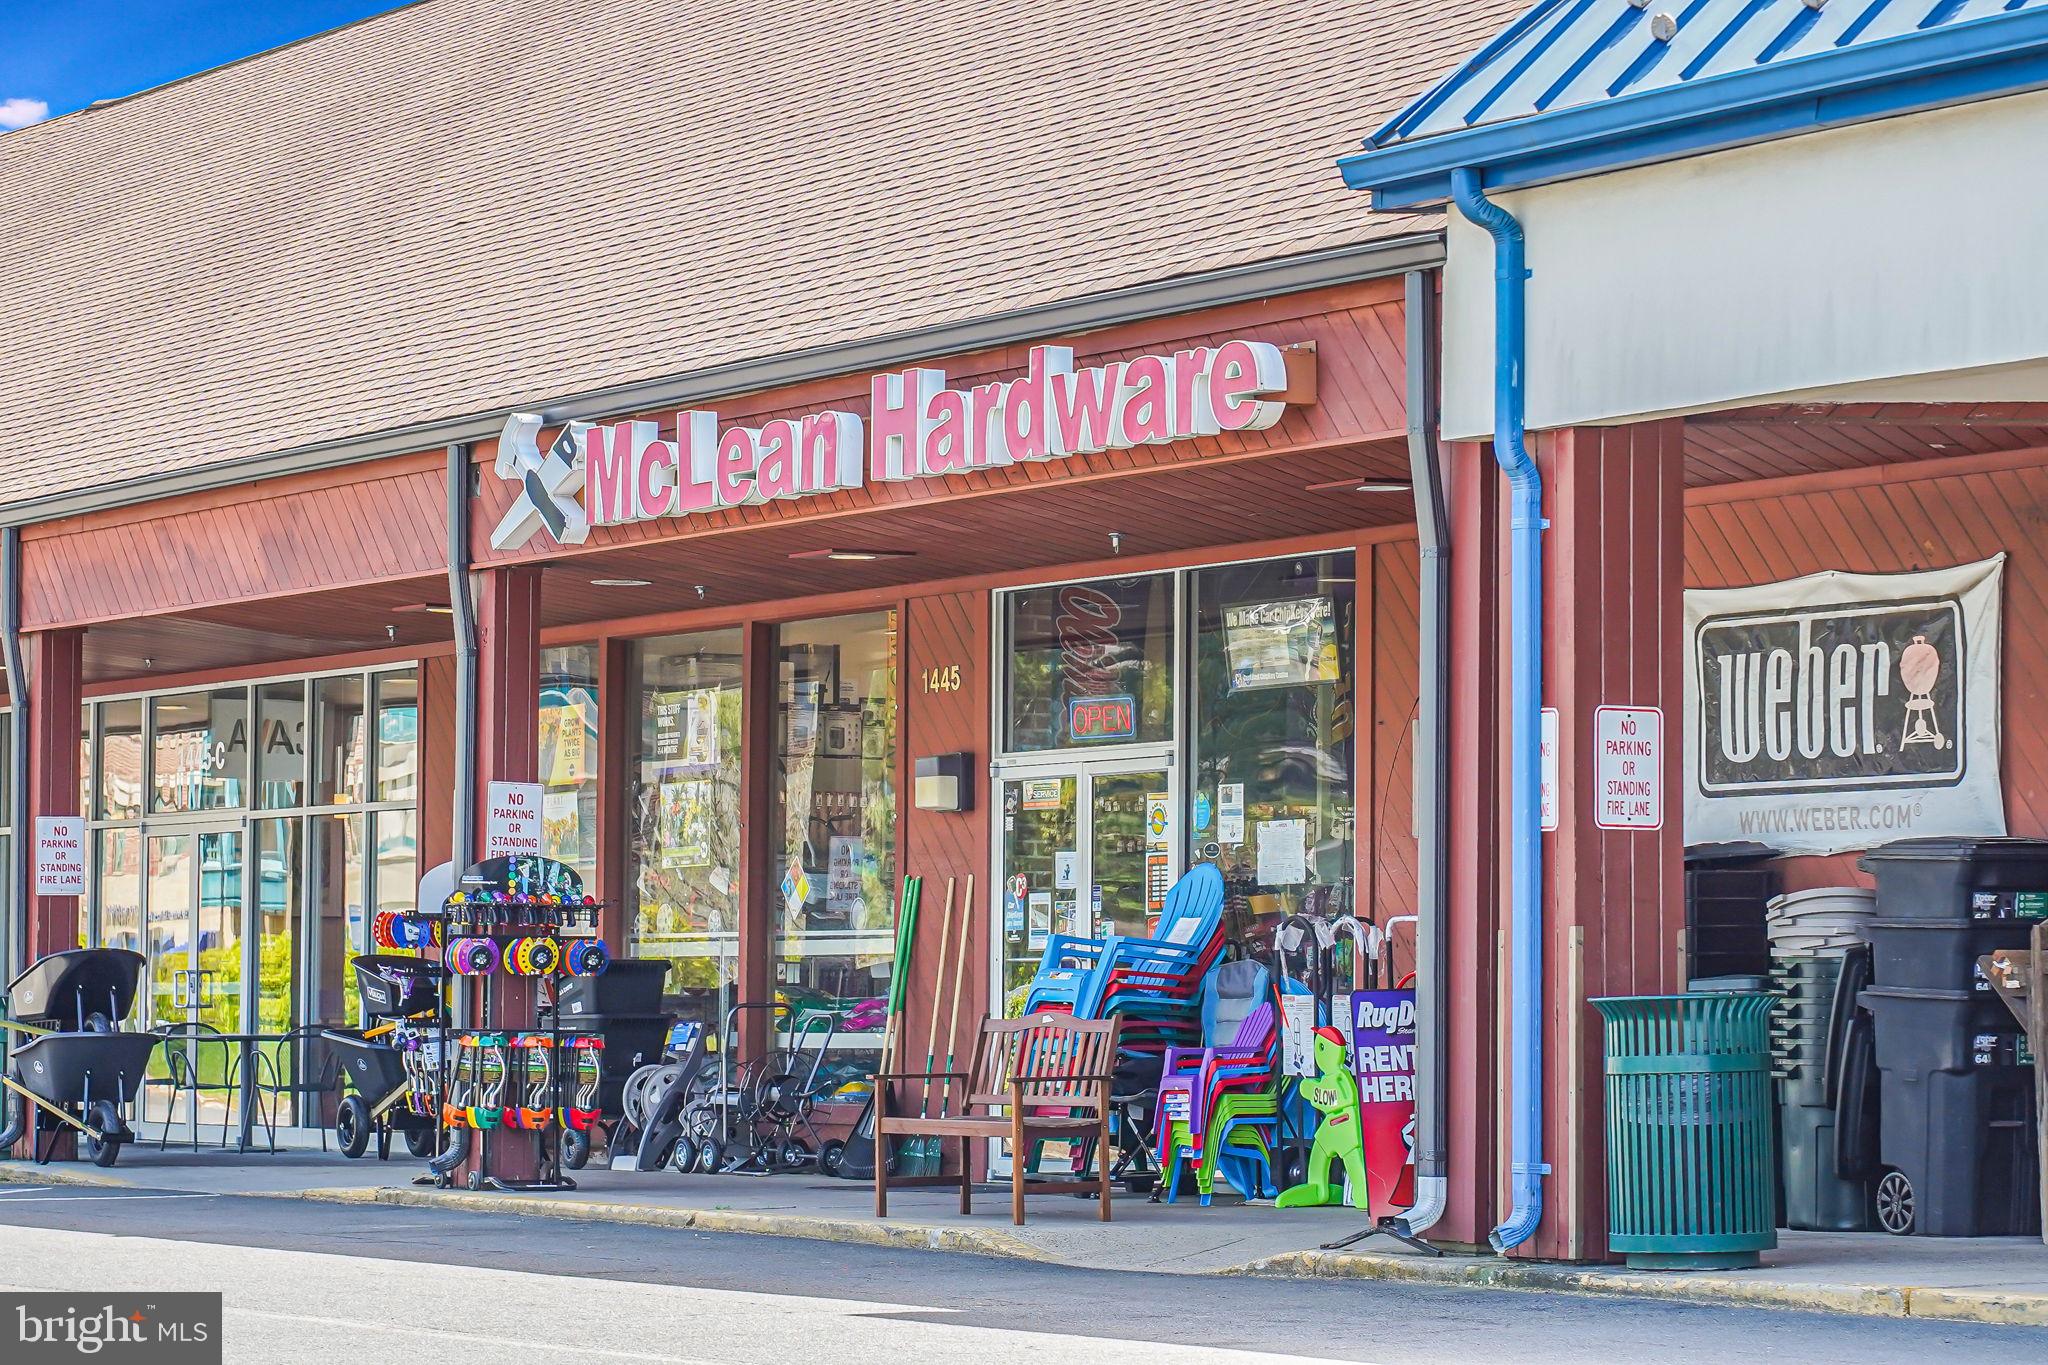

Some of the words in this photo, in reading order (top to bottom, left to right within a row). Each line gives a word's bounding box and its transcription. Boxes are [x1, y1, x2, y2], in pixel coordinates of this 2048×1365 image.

[585, 410, 858, 526] McLean
[870, 340, 1284, 482] Hardware
[1226, 613, 1238, 627] We
[1260, 609, 1273, 623] Car
[921, 664, 961, 694] 1445
[657, 705, 667, 716] THIS
[668, 703, 681, 715] STUFF
[563, 718, 581, 728] GROW
[1073, 703, 1131, 734] OPEN
[561, 728, 582, 738] PLANTS
[1621, 720, 1637, 736] NO
[563, 738, 581, 748] TWICE
[1606, 740, 1652, 757] PARKING
[564, 749, 571, 758] AS
[572, 748, 581, 757] BIG
[1622, 760, 1636, 776] OR
[1033, 789, 1058, 799] SERVICE
[1607, 780, 1651, 797] STANDING
[508, 793, 524, 806] NO
[493, 808, 534, 820] PARKING
[1607, 800, 1625, 816] FIRE
[1629, 801, 1650, 817] LANE
[53, 826, 68, 837] NO
[508, 823, 521, 834] OR
[41, 839, 78, 849] PARKING
[491, 836, 538, 849] STANDING
[55, 851, 67, 860] OR
[40, 863, 82, 872] STANDING
[40, 875, 58, 884] FIRE
[60, 875, 82, 884] LANE
[1975, 982, 1989, 991] 64
[1356, 1000, 1416, 1034] RugD
[1358, 1044, 1416, 1073] RENT
[1974, 1054, 1989, 1064] 64
